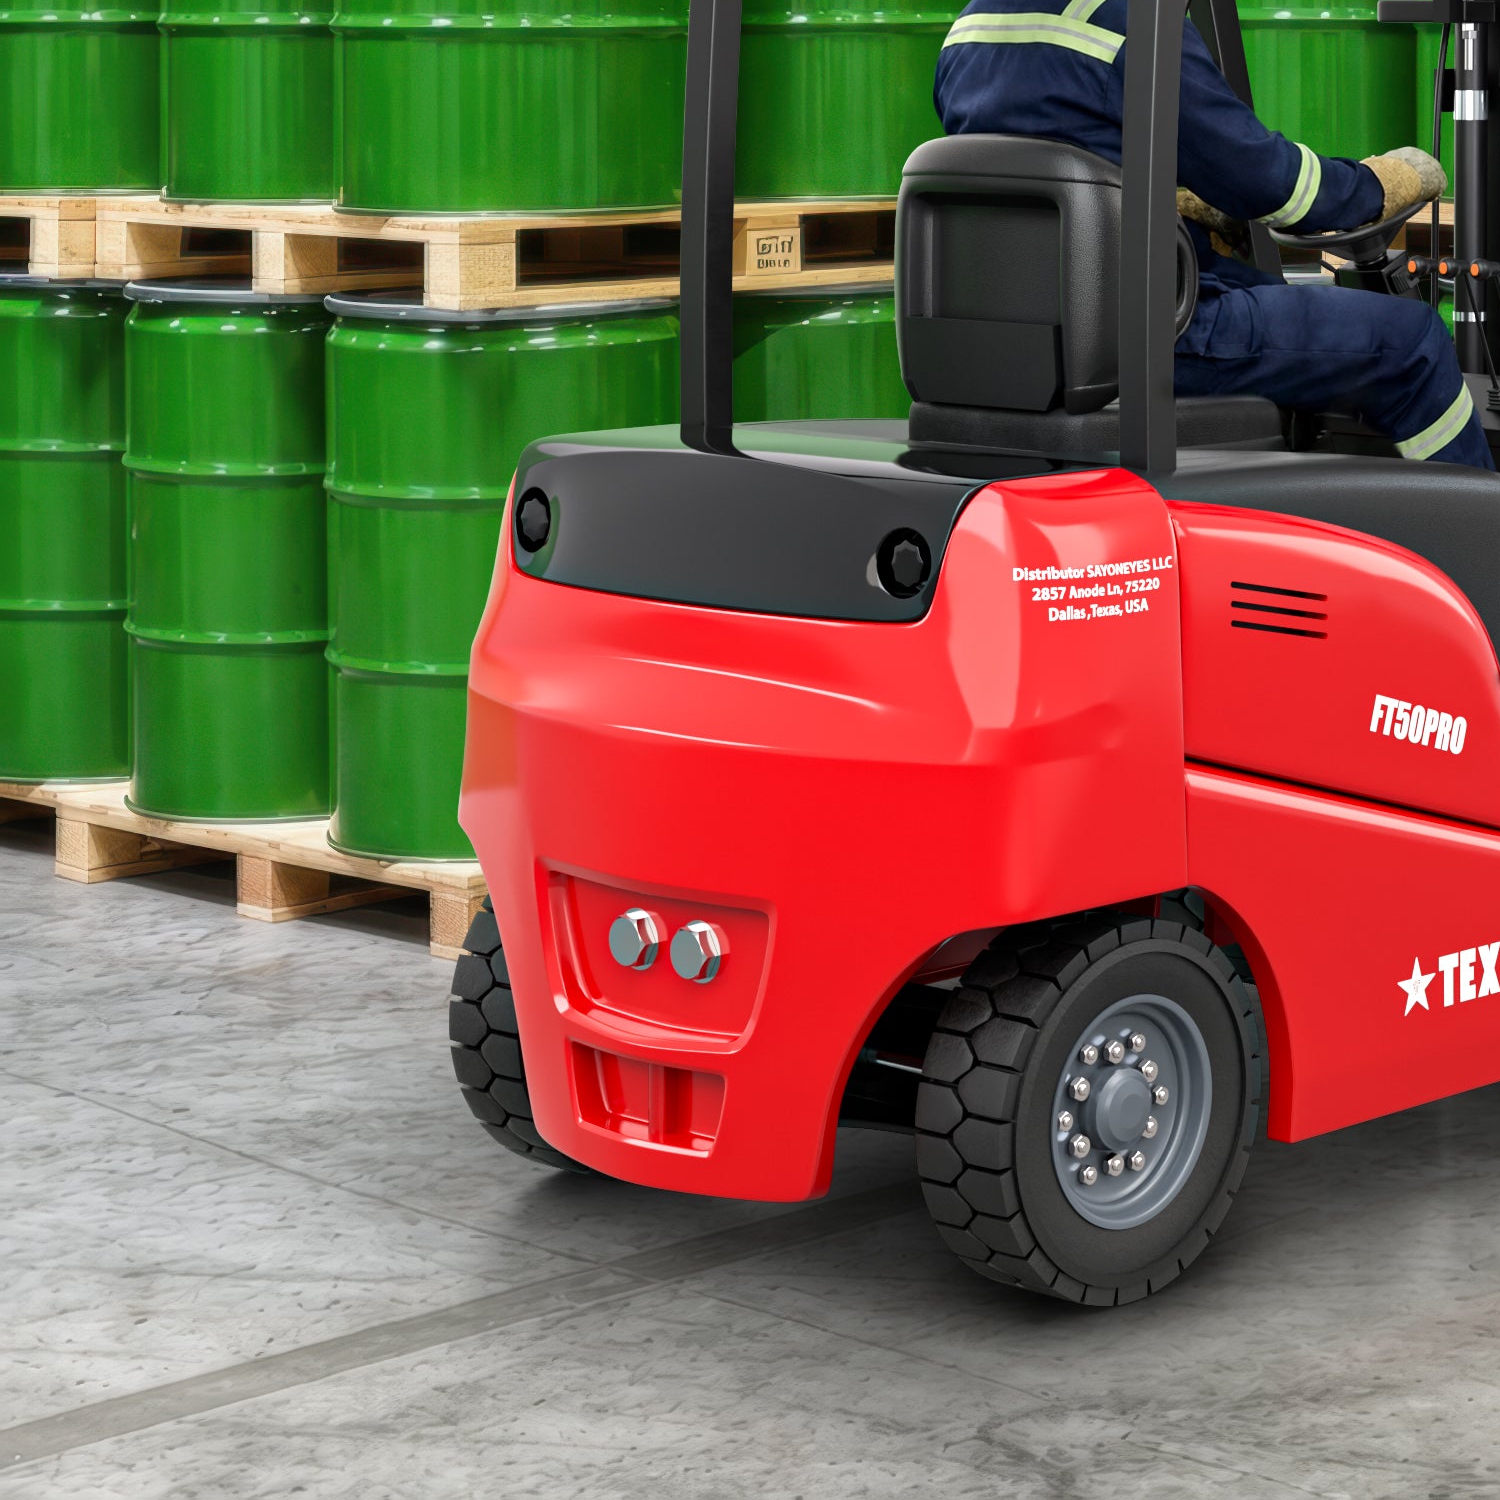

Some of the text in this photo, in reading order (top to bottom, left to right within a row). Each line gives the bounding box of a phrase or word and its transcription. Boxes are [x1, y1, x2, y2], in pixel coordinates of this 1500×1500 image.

[1012, 555, 1173, 582] Distributor SAYONEYES LLC
[1031, 577, 1160, 601] 2857 Anode Ln, 75220
[1124, 597, 1149, 614] USA
[1369, 694, 1468, 755] FT50PRO
